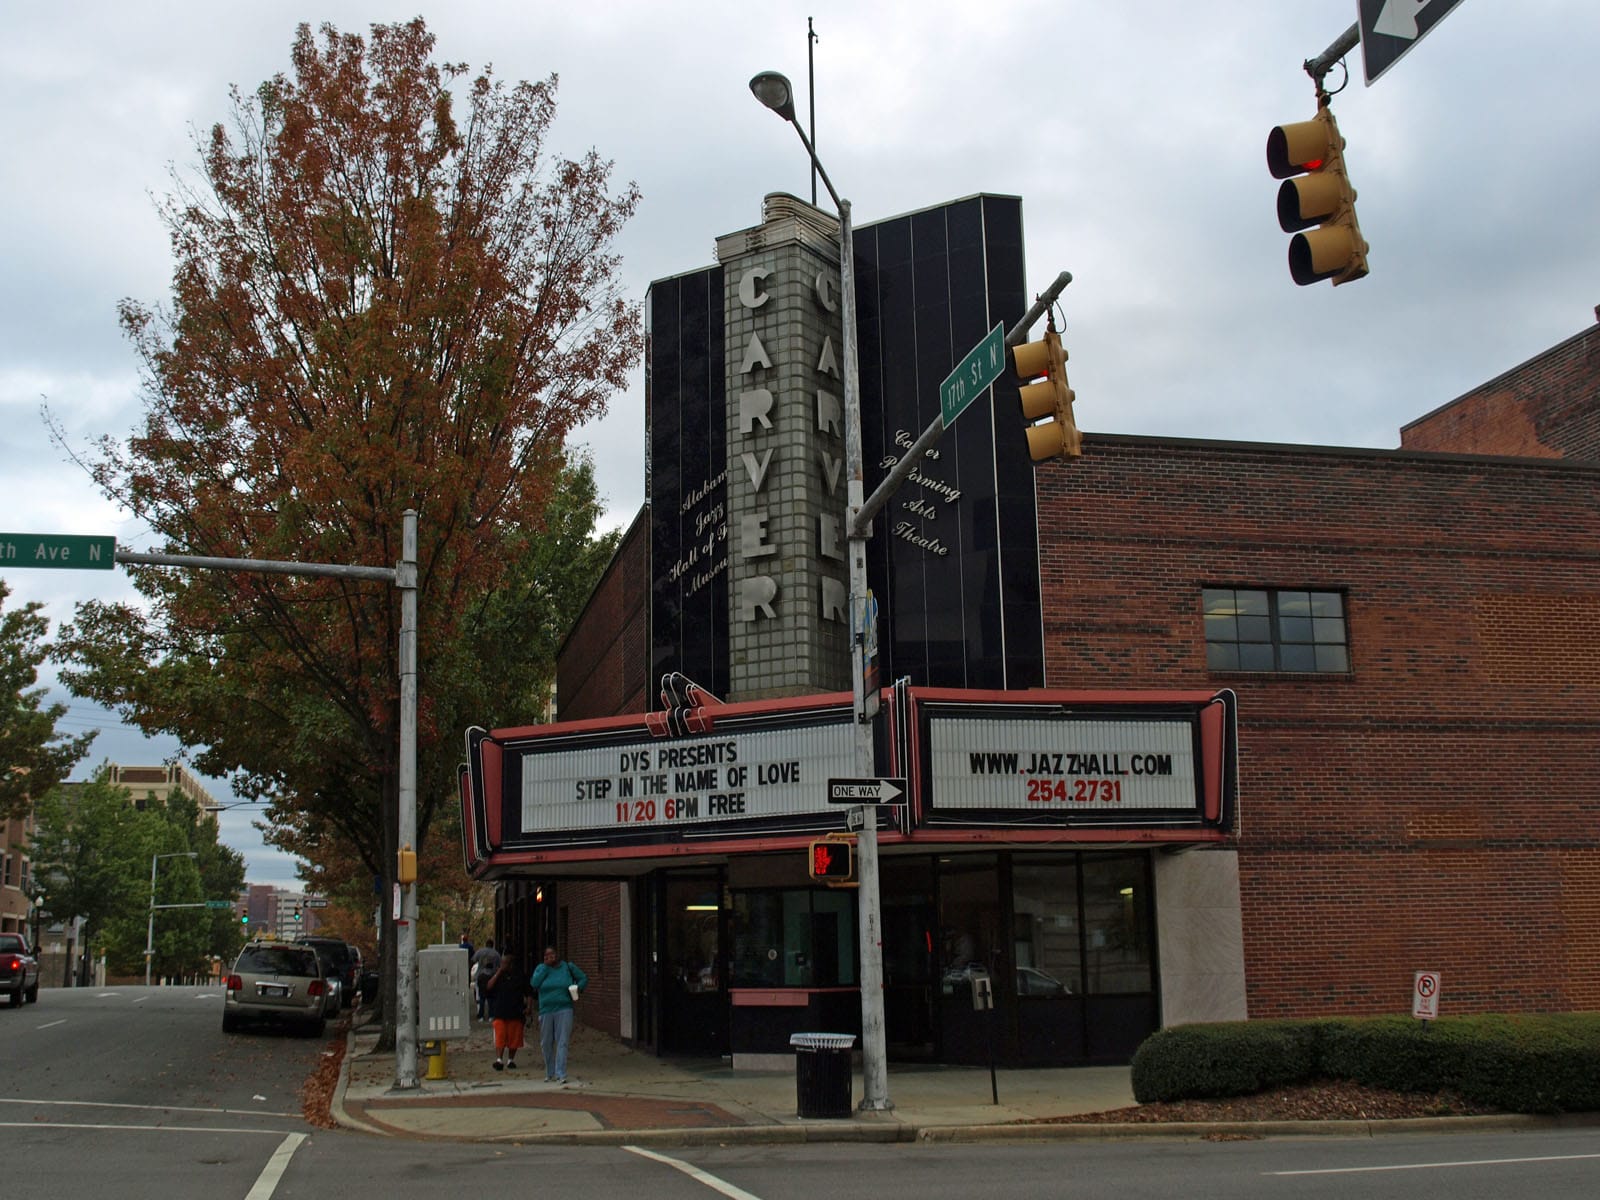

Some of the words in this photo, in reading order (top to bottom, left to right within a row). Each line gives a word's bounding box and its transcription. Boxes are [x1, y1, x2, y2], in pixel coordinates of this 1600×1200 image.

[947, 377, 965, 411] 17th
[971, 358, 983, 386] St
[989, 342, 997, 369] N
[738, 267, 777, 622] CARVER
[816, 270, 847, 624] CARVER
[894, 429, 940, 460] Caer
[680, 468, 728, 515] Alabam
[695, 502, 724, 537] Jazz
[902, 499, 936, 520] Arts
[35, 542, 70, 560] Ave
[89, 543, 101, 561] N
[892, 521, 948, 556] Theatre
[669, 546, 699, 582] Hall
[702, 531, 715, 556] of
[685, 557, 728, 597] Museu
[620, 751, 650, 773] DYS
[658, 741, 737, 769] PRESENTS
[969, 752, 1173, 776] WWW.JAZZHALL.COM
[575, 779, 612, 801] STEP
[618, 778, 633, 797] IN
[640, 774, 668, 795] THE
[675, 768, 718, 793] NAME
[727, 766, 748, 788] OF
[758, 761, 801, 786] LOVE
[833, 786, 855, 797] ONE
[858, 786, 881, 797] WAY
[1026, 779, 1122, 802] 254.2731
[616, 799, 656, 823] 11/20
[664, 797, 699, 820] 6PM
[708, 793, 745, 816] FREE
